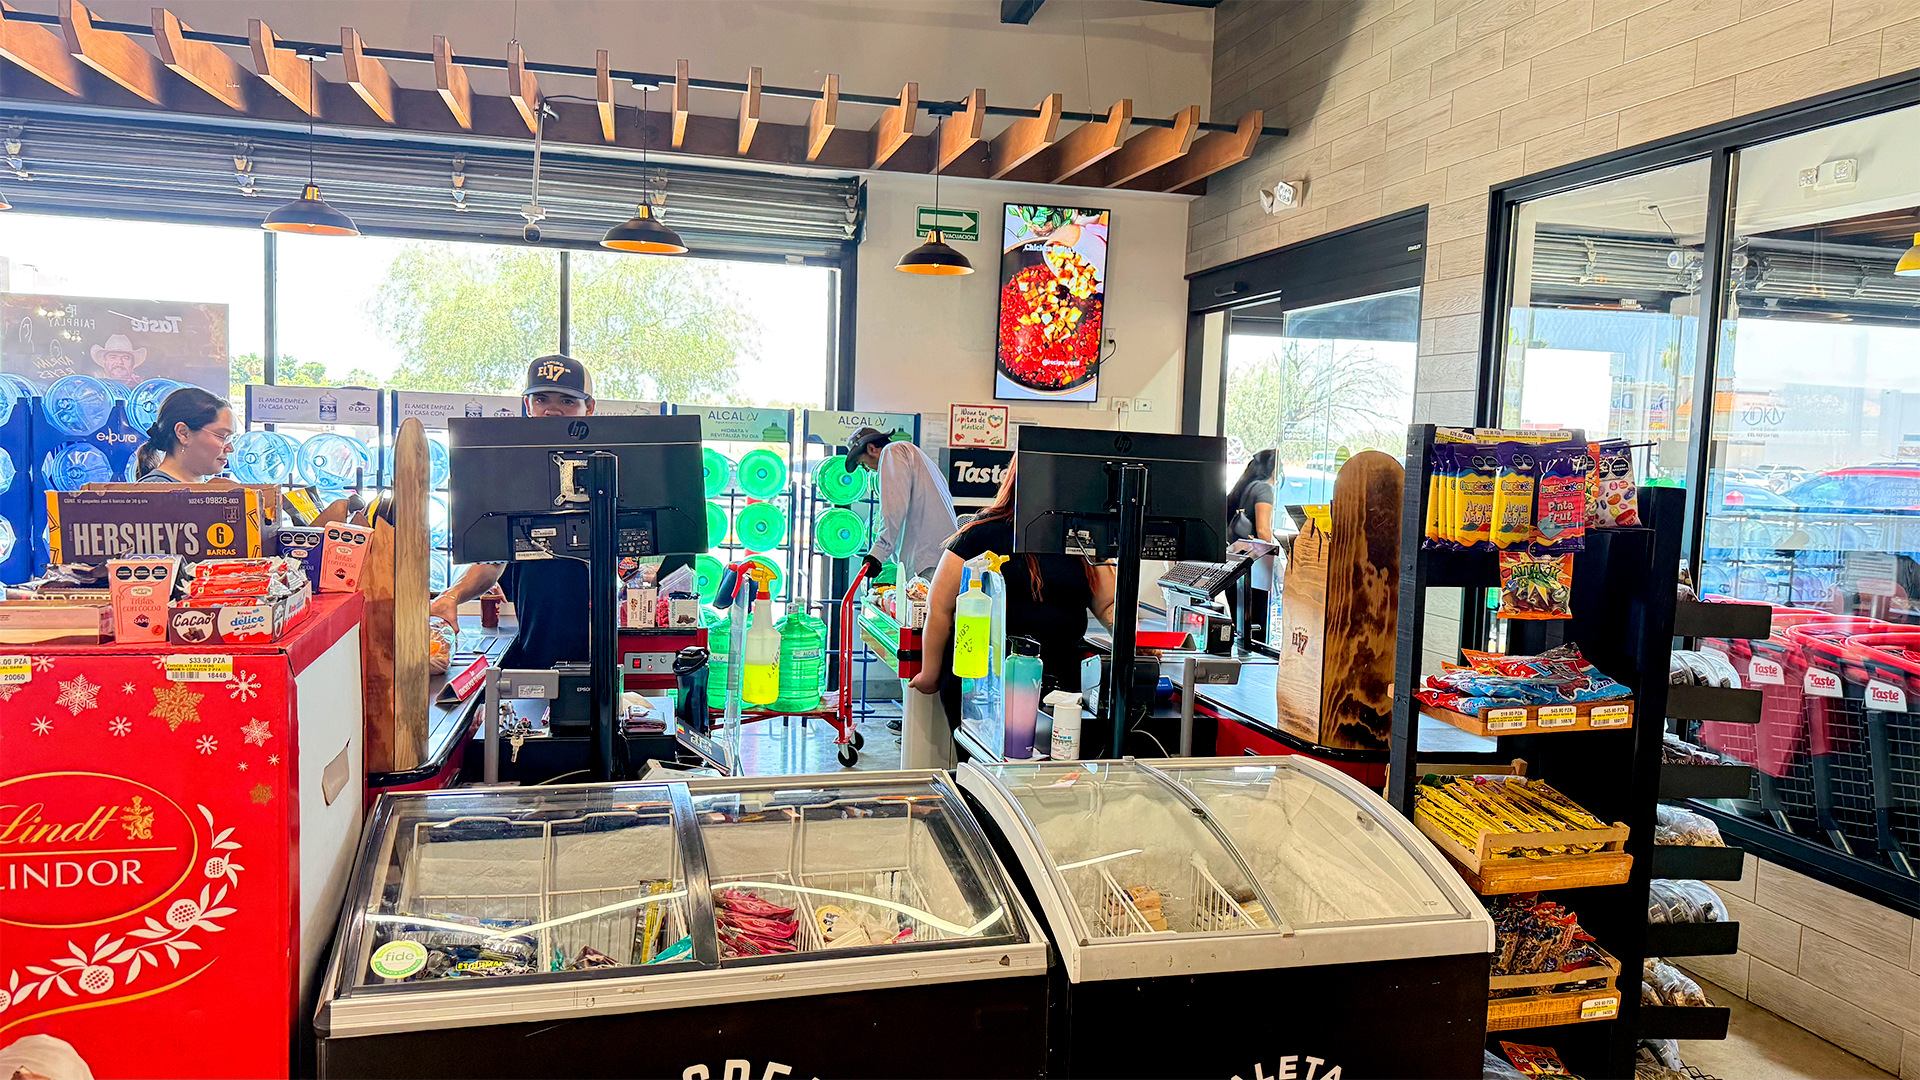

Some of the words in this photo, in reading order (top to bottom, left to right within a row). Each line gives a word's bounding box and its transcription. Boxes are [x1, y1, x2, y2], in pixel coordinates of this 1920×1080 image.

[1547, 501, 1575, 512] Pinta
[73, 522, 200, 556] HERSHEY'S
[216, 526, 225, 545] 6
[206, 548, 237, 556] BARRAS
[1752, 662, 1778, 675] Taste
[1808, 673, 1836, 687] Taste
[1869, 686, 1900, 701] Taste
[0, 801, 119, 844] Lindt
[385, 951, 415, 961] fide
